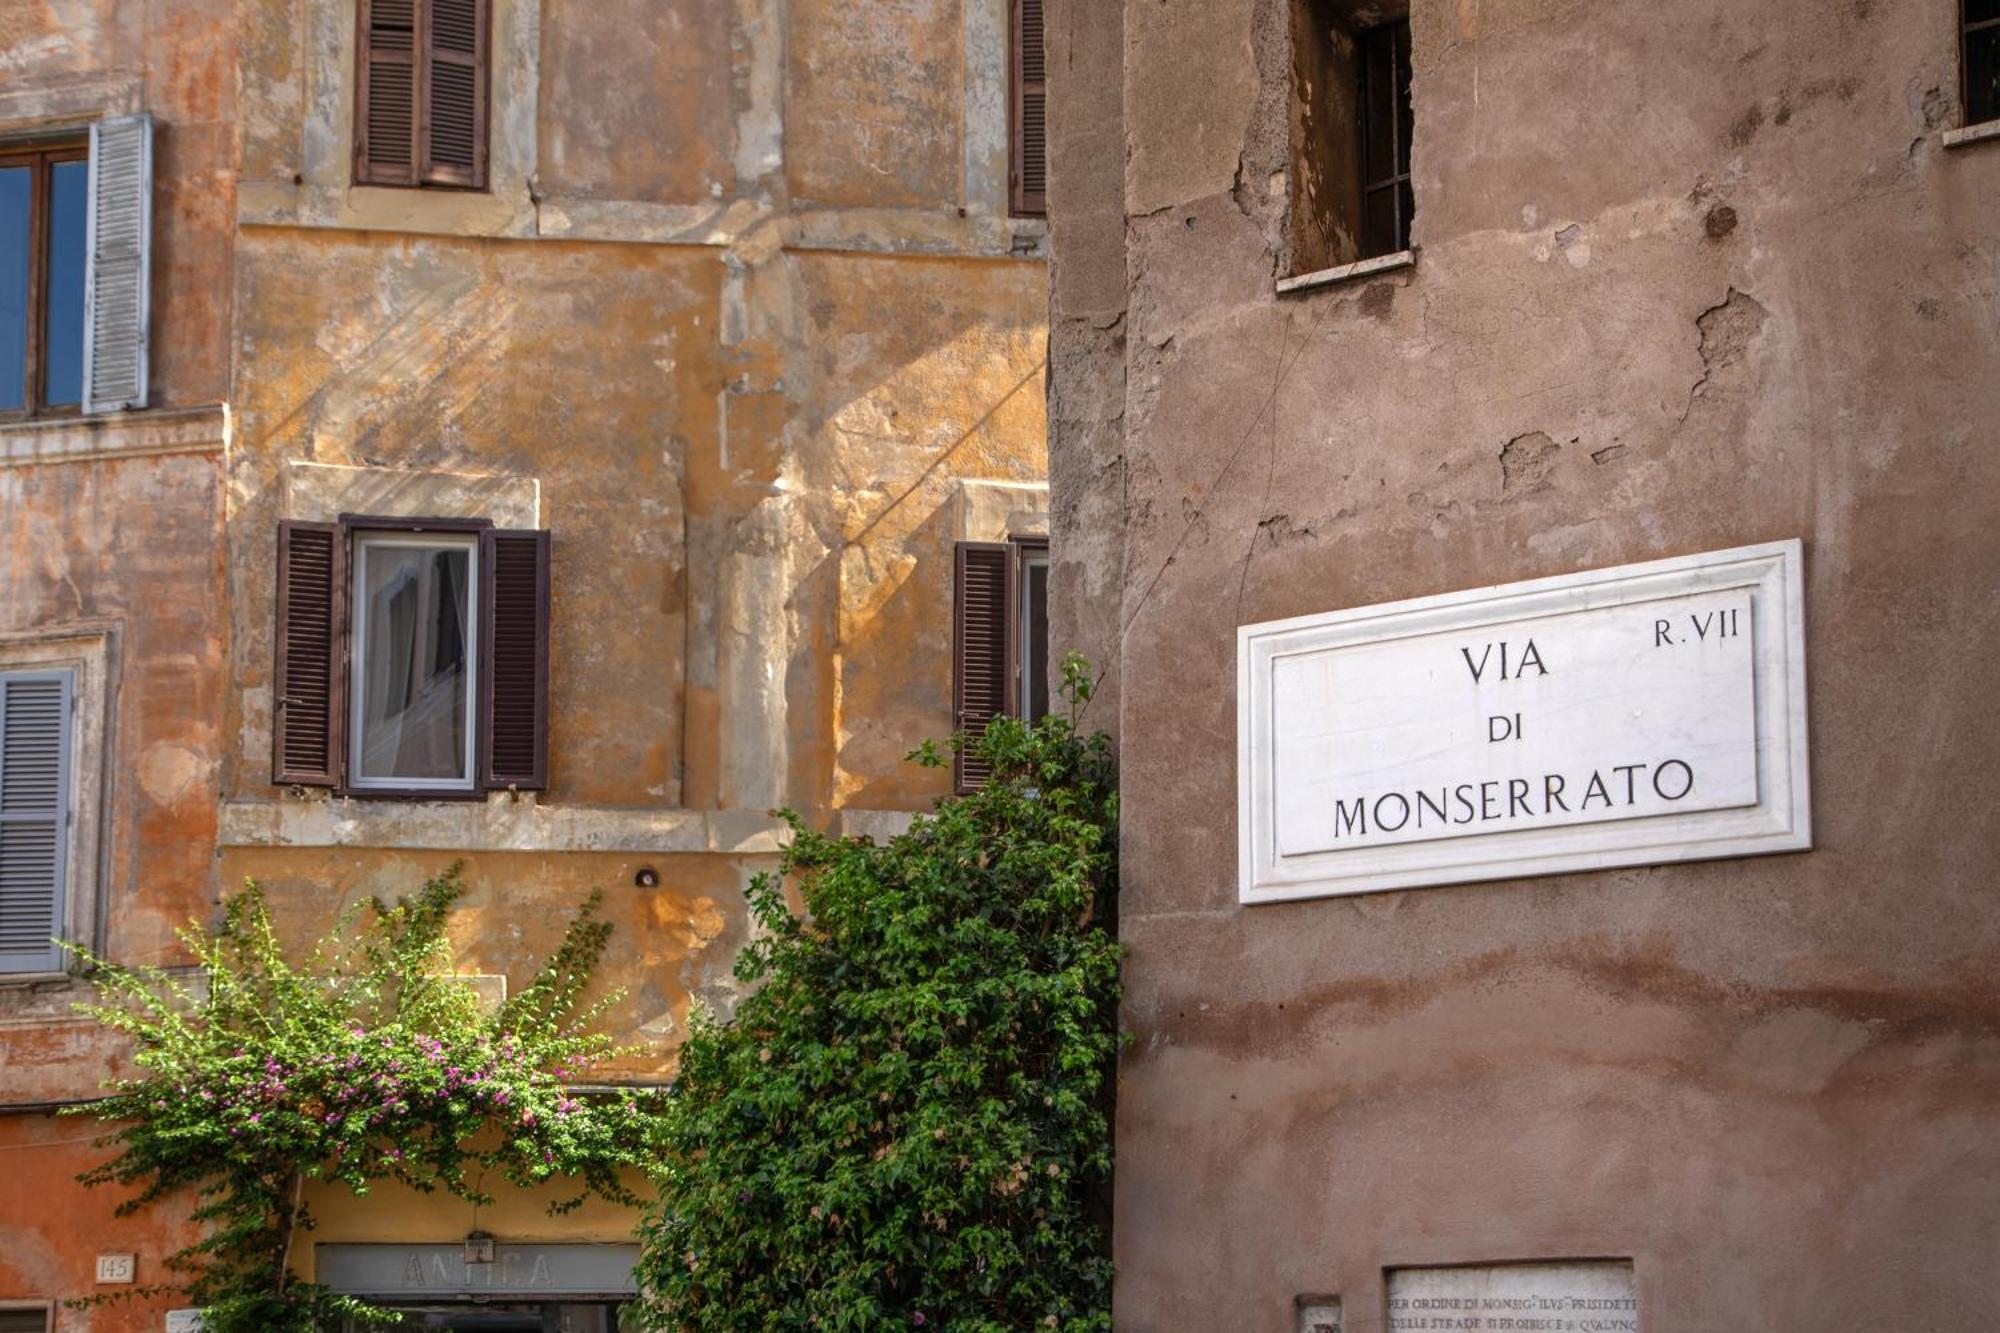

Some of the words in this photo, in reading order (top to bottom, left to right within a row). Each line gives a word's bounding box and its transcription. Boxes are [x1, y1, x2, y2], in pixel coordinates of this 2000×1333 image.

[1461, 639, 1549, 684] VIA
[1488, 713, 1522, 743] DI
[1335, 759, 1694, 838] MONSERRATO
[100, 1259, 128, 1277] 145
[1388, 1298, 1409, 1309] PER
[1412, 1298, 1460, 1309] ORDINE
[1464, 1298, 1478, 1309] DI
[1391, 1318, 1428, 1329] DELLE
[1430, 1318, 1481, 1329] STRADE
